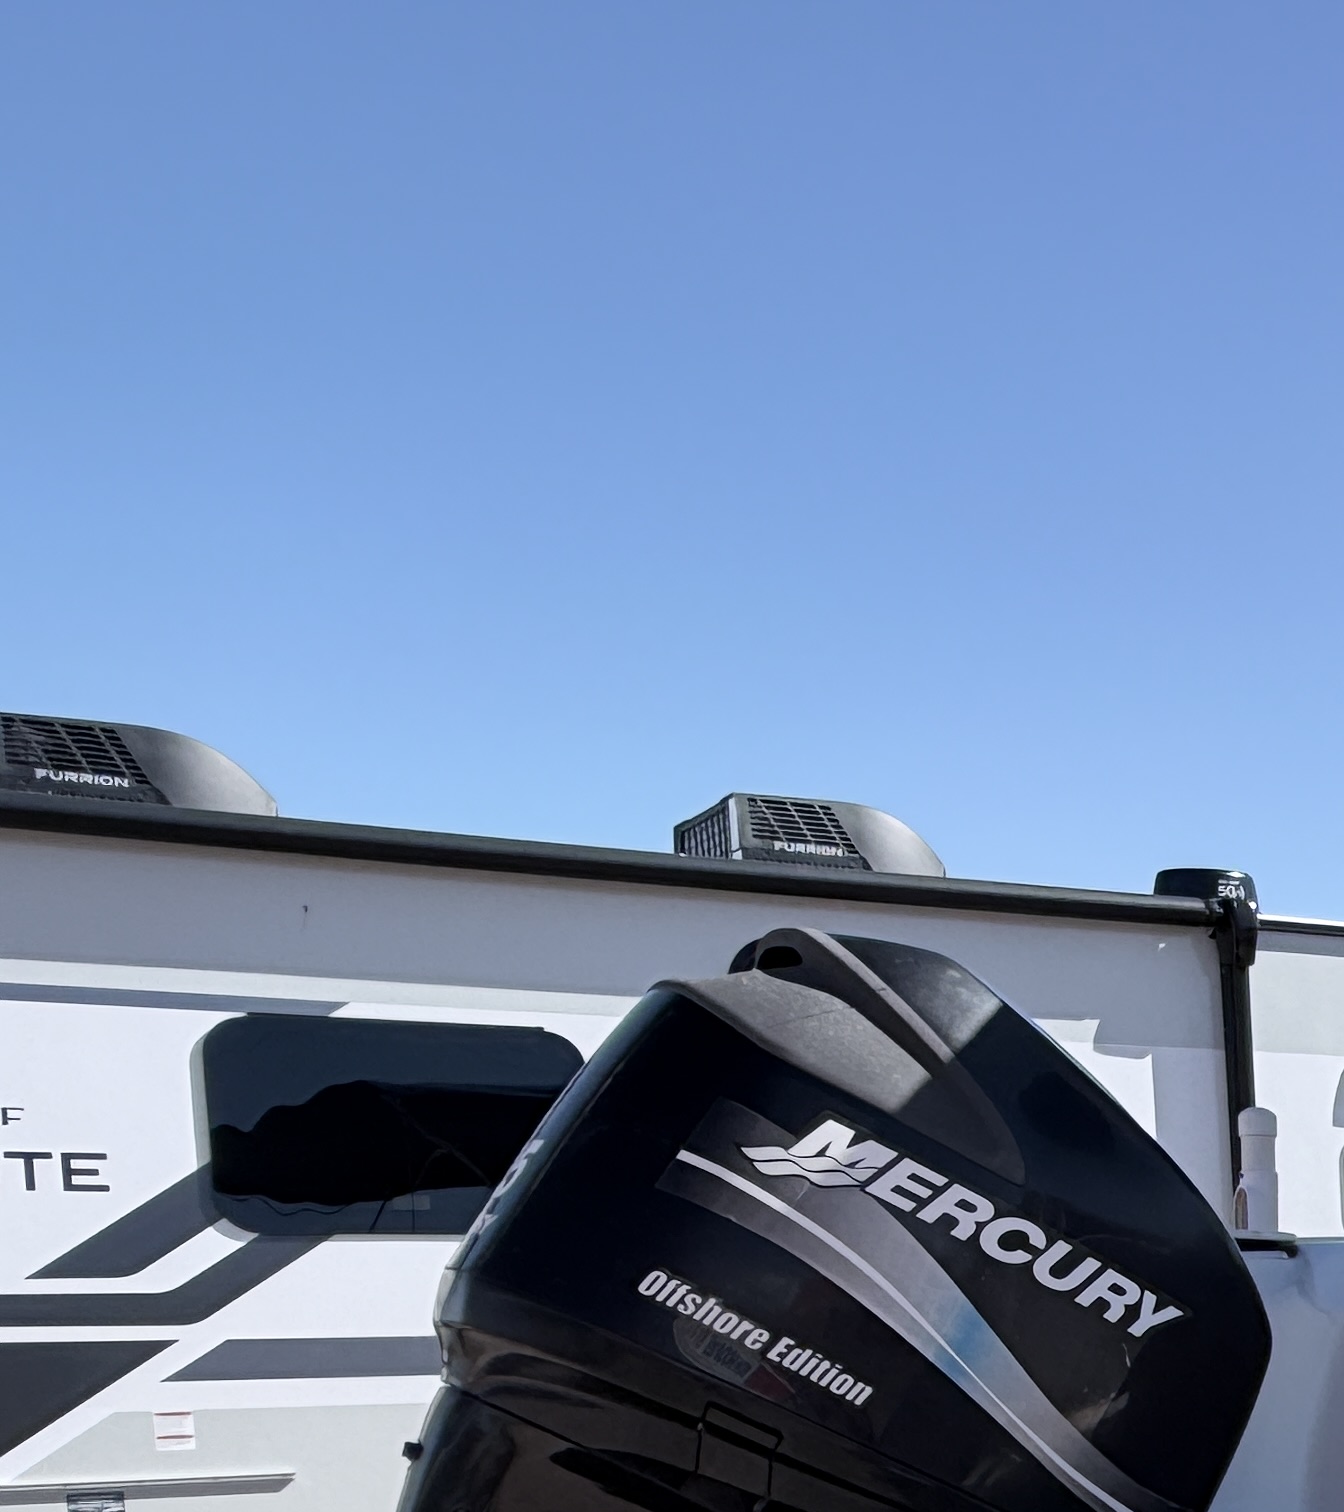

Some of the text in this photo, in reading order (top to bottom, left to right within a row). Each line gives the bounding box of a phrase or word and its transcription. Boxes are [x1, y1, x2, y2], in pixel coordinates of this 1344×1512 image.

[34, 768, 130, 788] FURRION
[750, 1119, 1185, 1338] MERCURY
[637, 1269, 874, 1406] Offshore Edition
